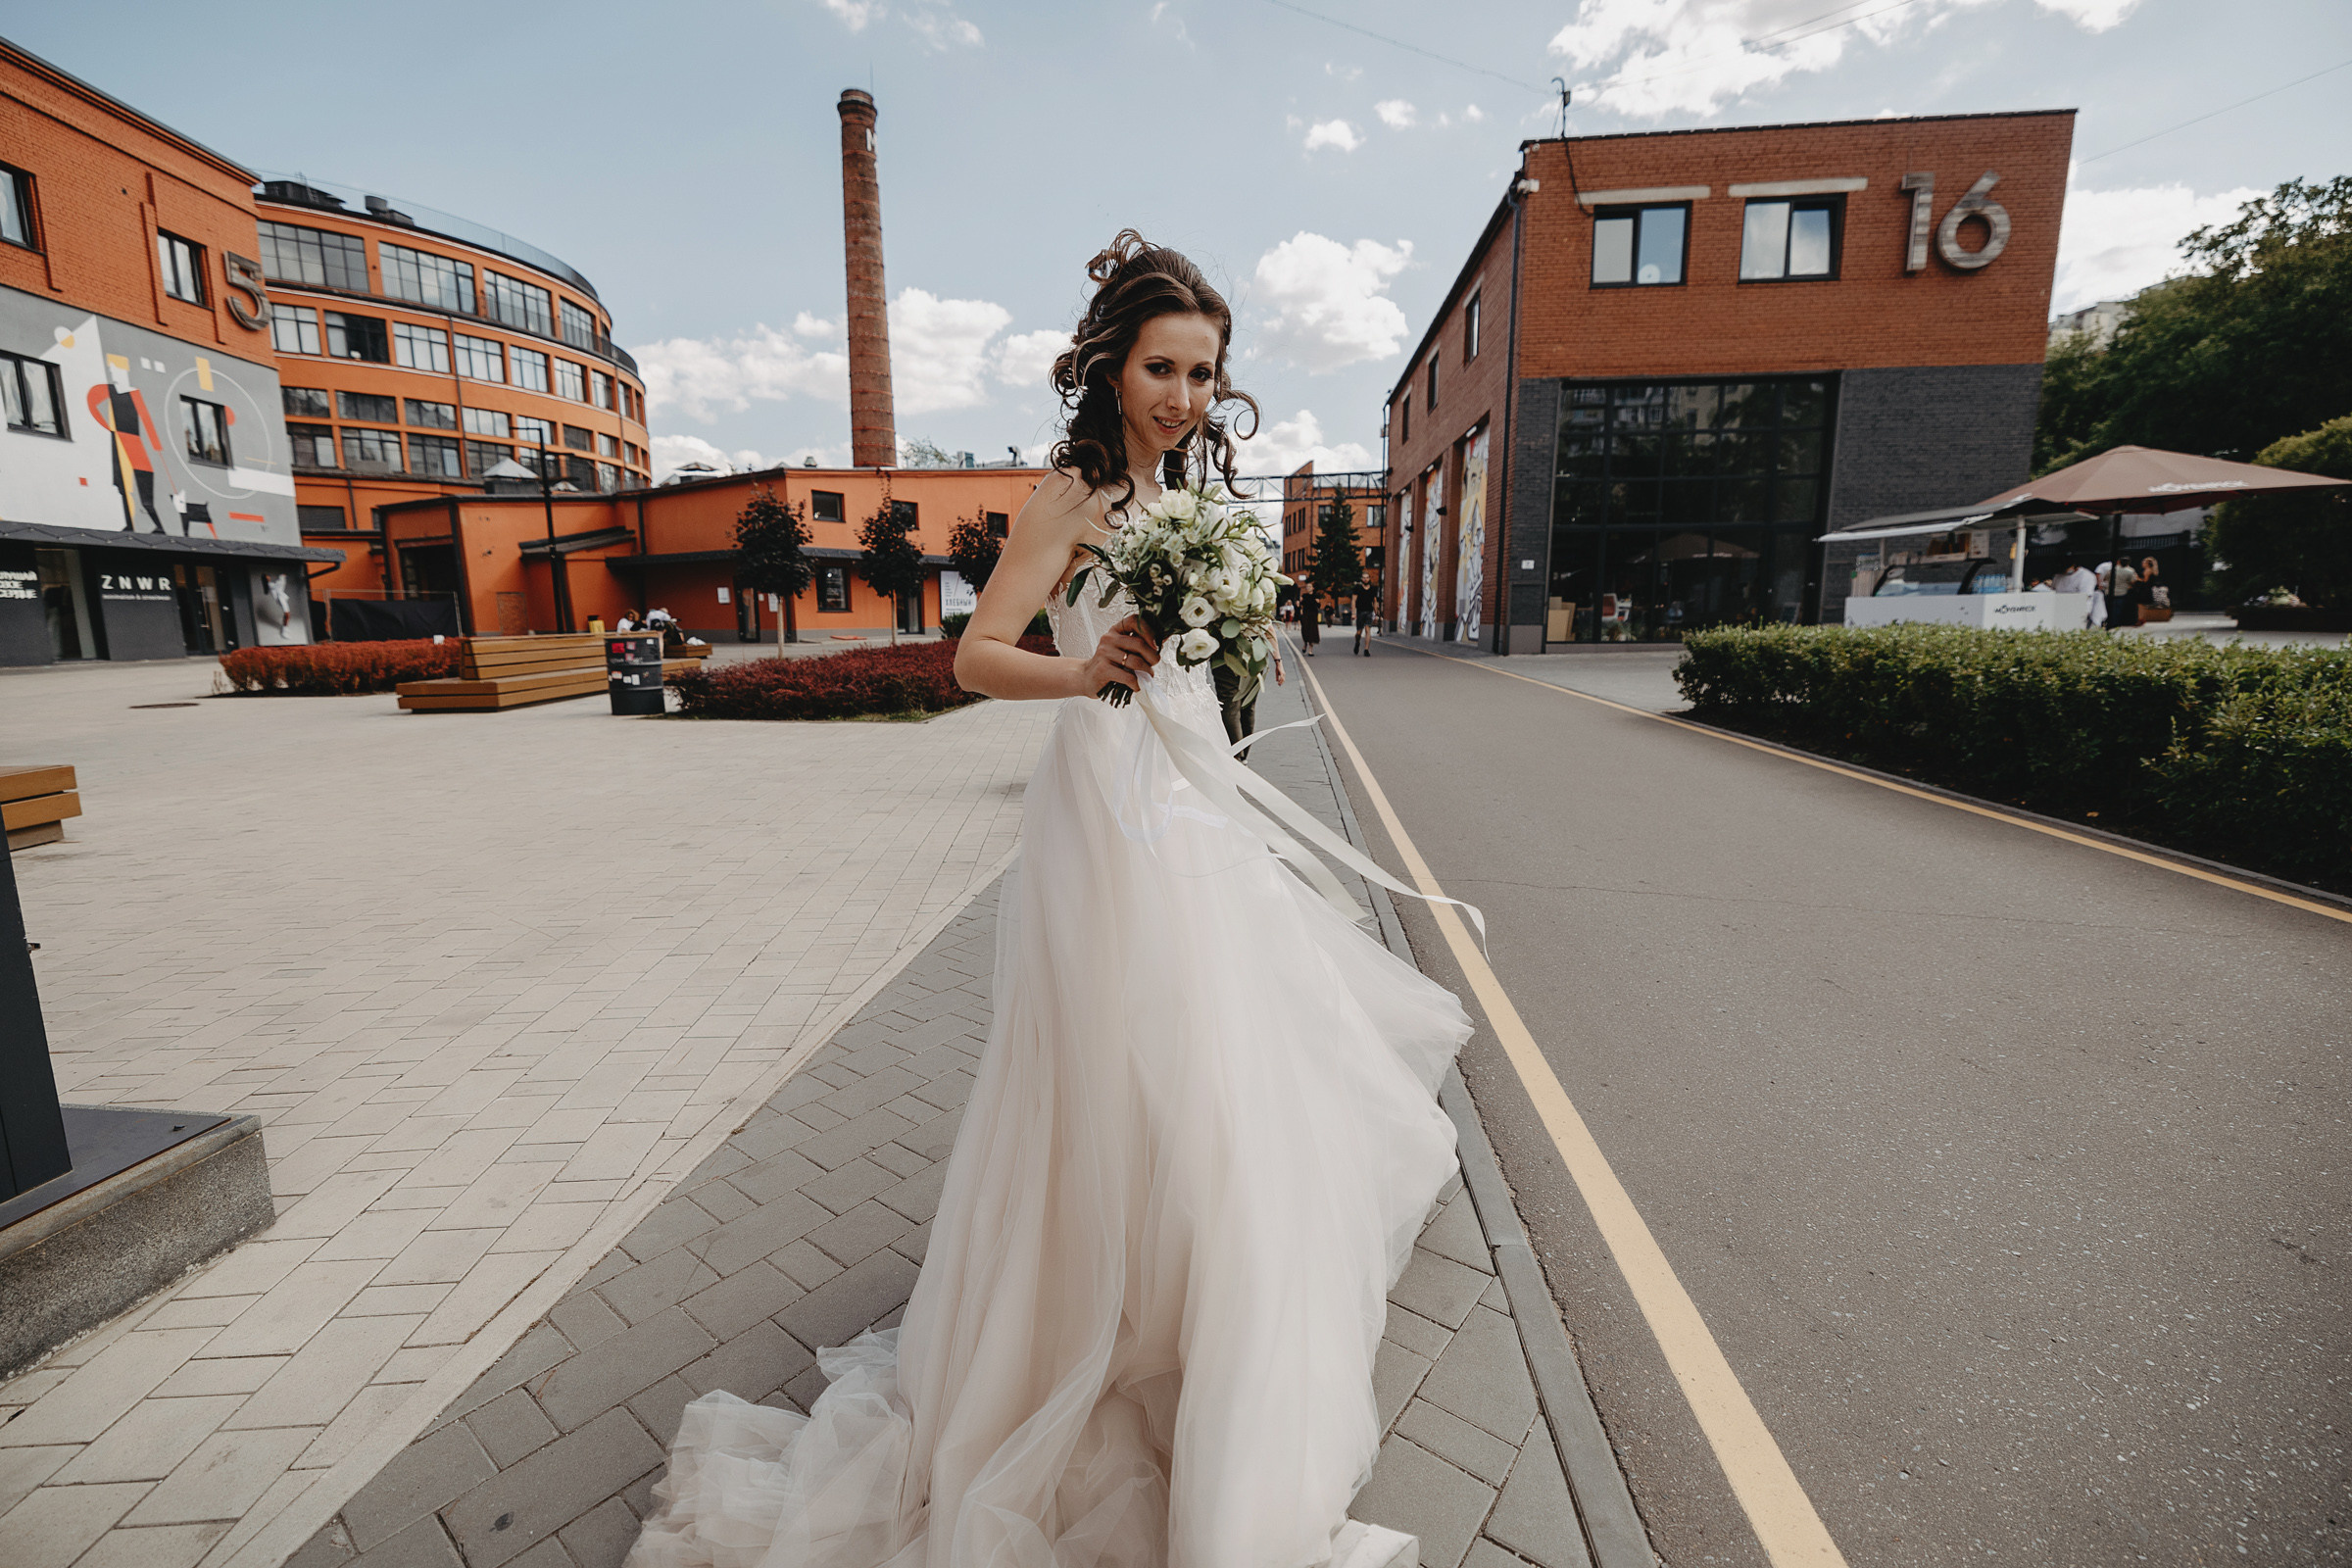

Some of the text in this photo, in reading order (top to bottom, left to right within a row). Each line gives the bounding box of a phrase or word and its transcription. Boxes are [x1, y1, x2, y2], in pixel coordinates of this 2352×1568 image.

[1901, 170, 2011, 270] 16
[223, 250, 271, 330] 5
[101, 574, 172, 591] ZNWR
